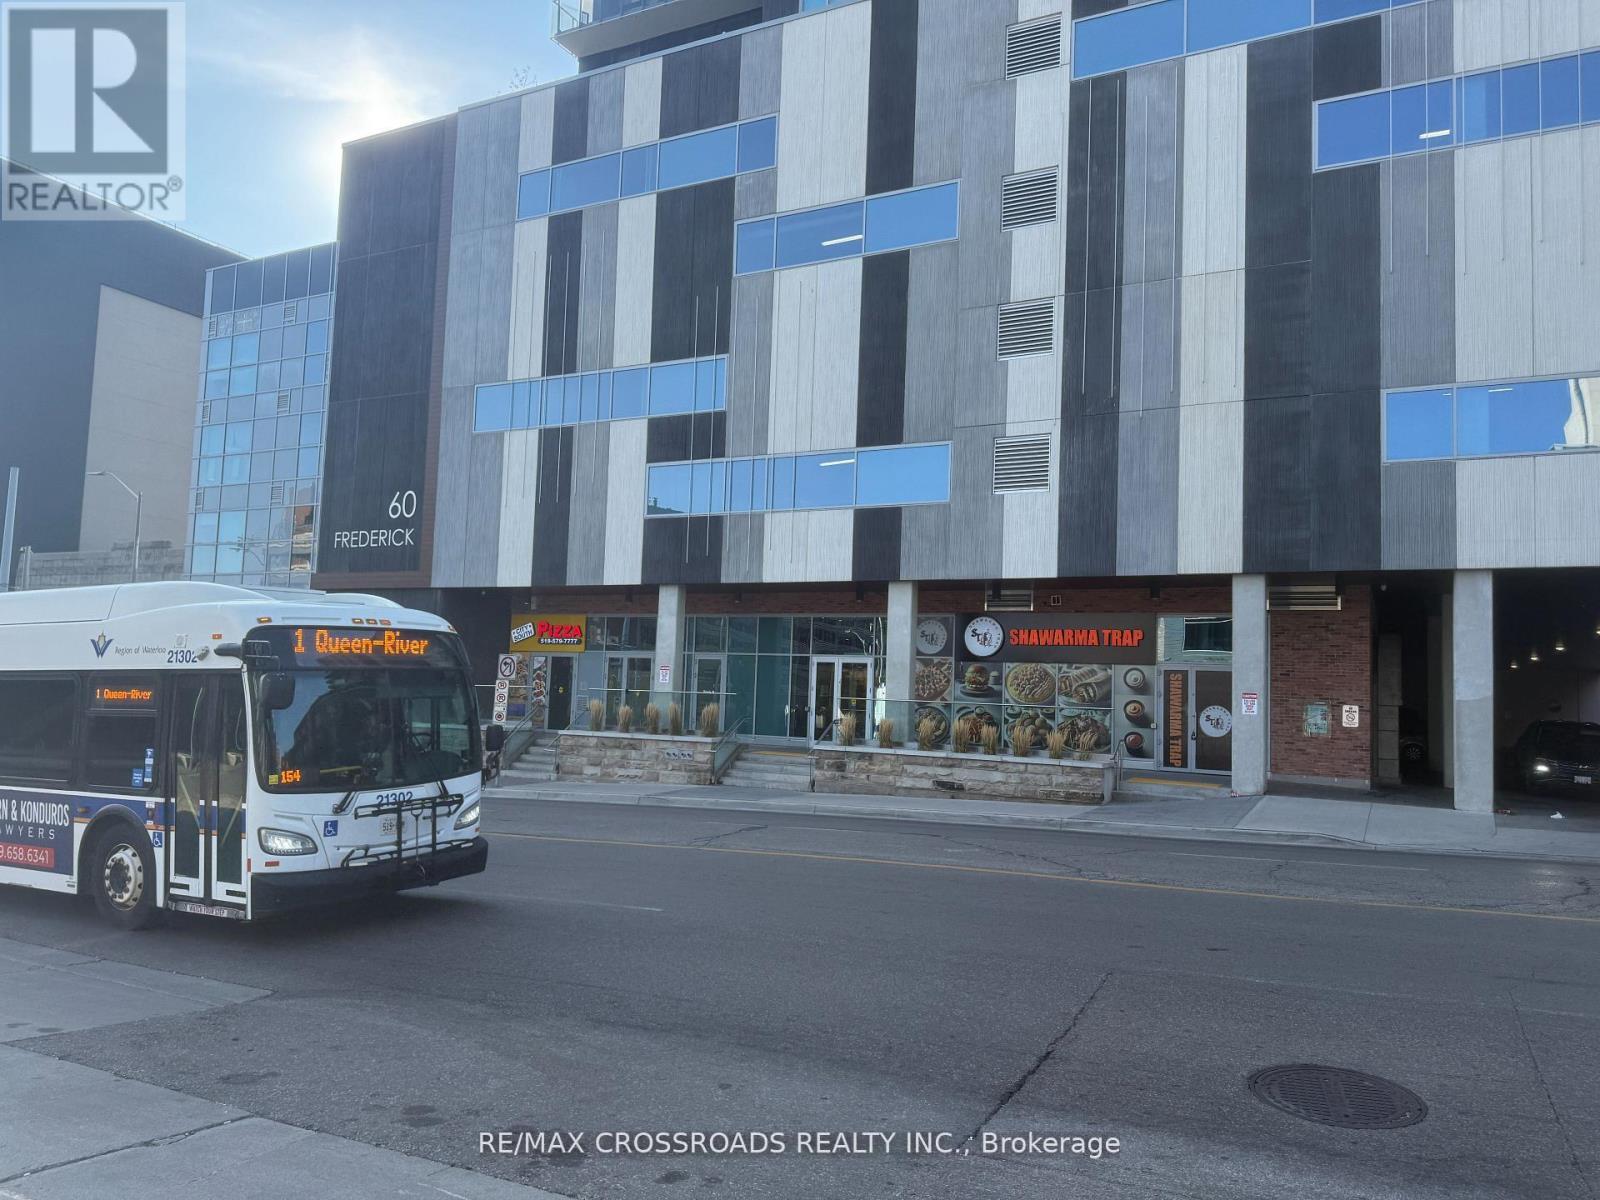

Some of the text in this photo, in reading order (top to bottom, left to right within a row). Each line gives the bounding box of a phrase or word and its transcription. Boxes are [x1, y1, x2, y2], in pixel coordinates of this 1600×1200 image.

[388, 490, 417, 519] 60
[334, 528, 415, 549] FREDERICK
[294, 628, 429, 655] 1 Queen-River
[513, 629, 533, 641] SOUTH
[1009, 628, 1099, 646] SHAWARMA
[1101, 629, 1144, 647] TRAP
[115, 646, 133, 656] Region
[167, 649, 198, 664] 21302
[103, 688, 153, 701] Queen-River
[1169, 673, 1182, 767] SHAWARMA TRAP
[281, 769, 302, 785] 154
[11, 799, 18, 821] &
[20, 800, 70, 827] KONDUROS
